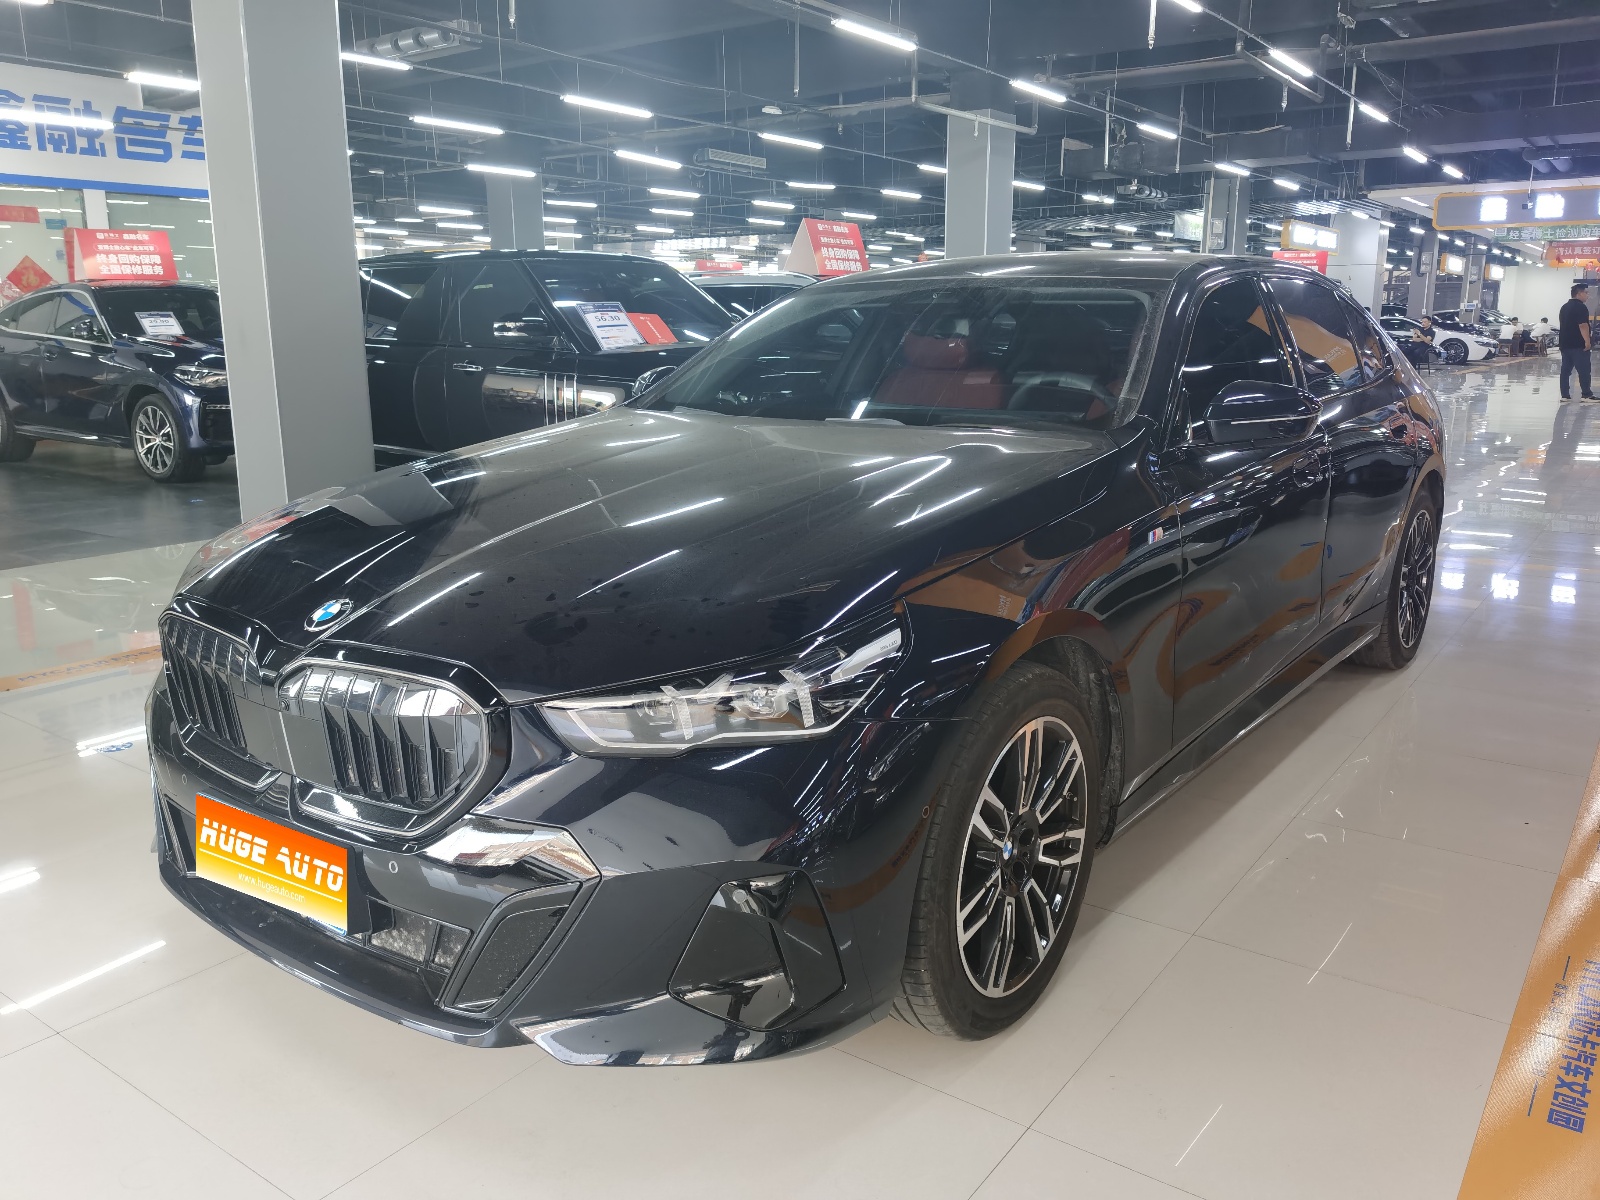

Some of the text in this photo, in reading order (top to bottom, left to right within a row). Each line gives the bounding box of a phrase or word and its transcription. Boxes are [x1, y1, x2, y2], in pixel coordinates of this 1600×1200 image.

[95, 253, 162, 264] 终身回购保障
[99, 264, 164, 275] 全国保修服务
[594, 314, 621, 323] 56.30
